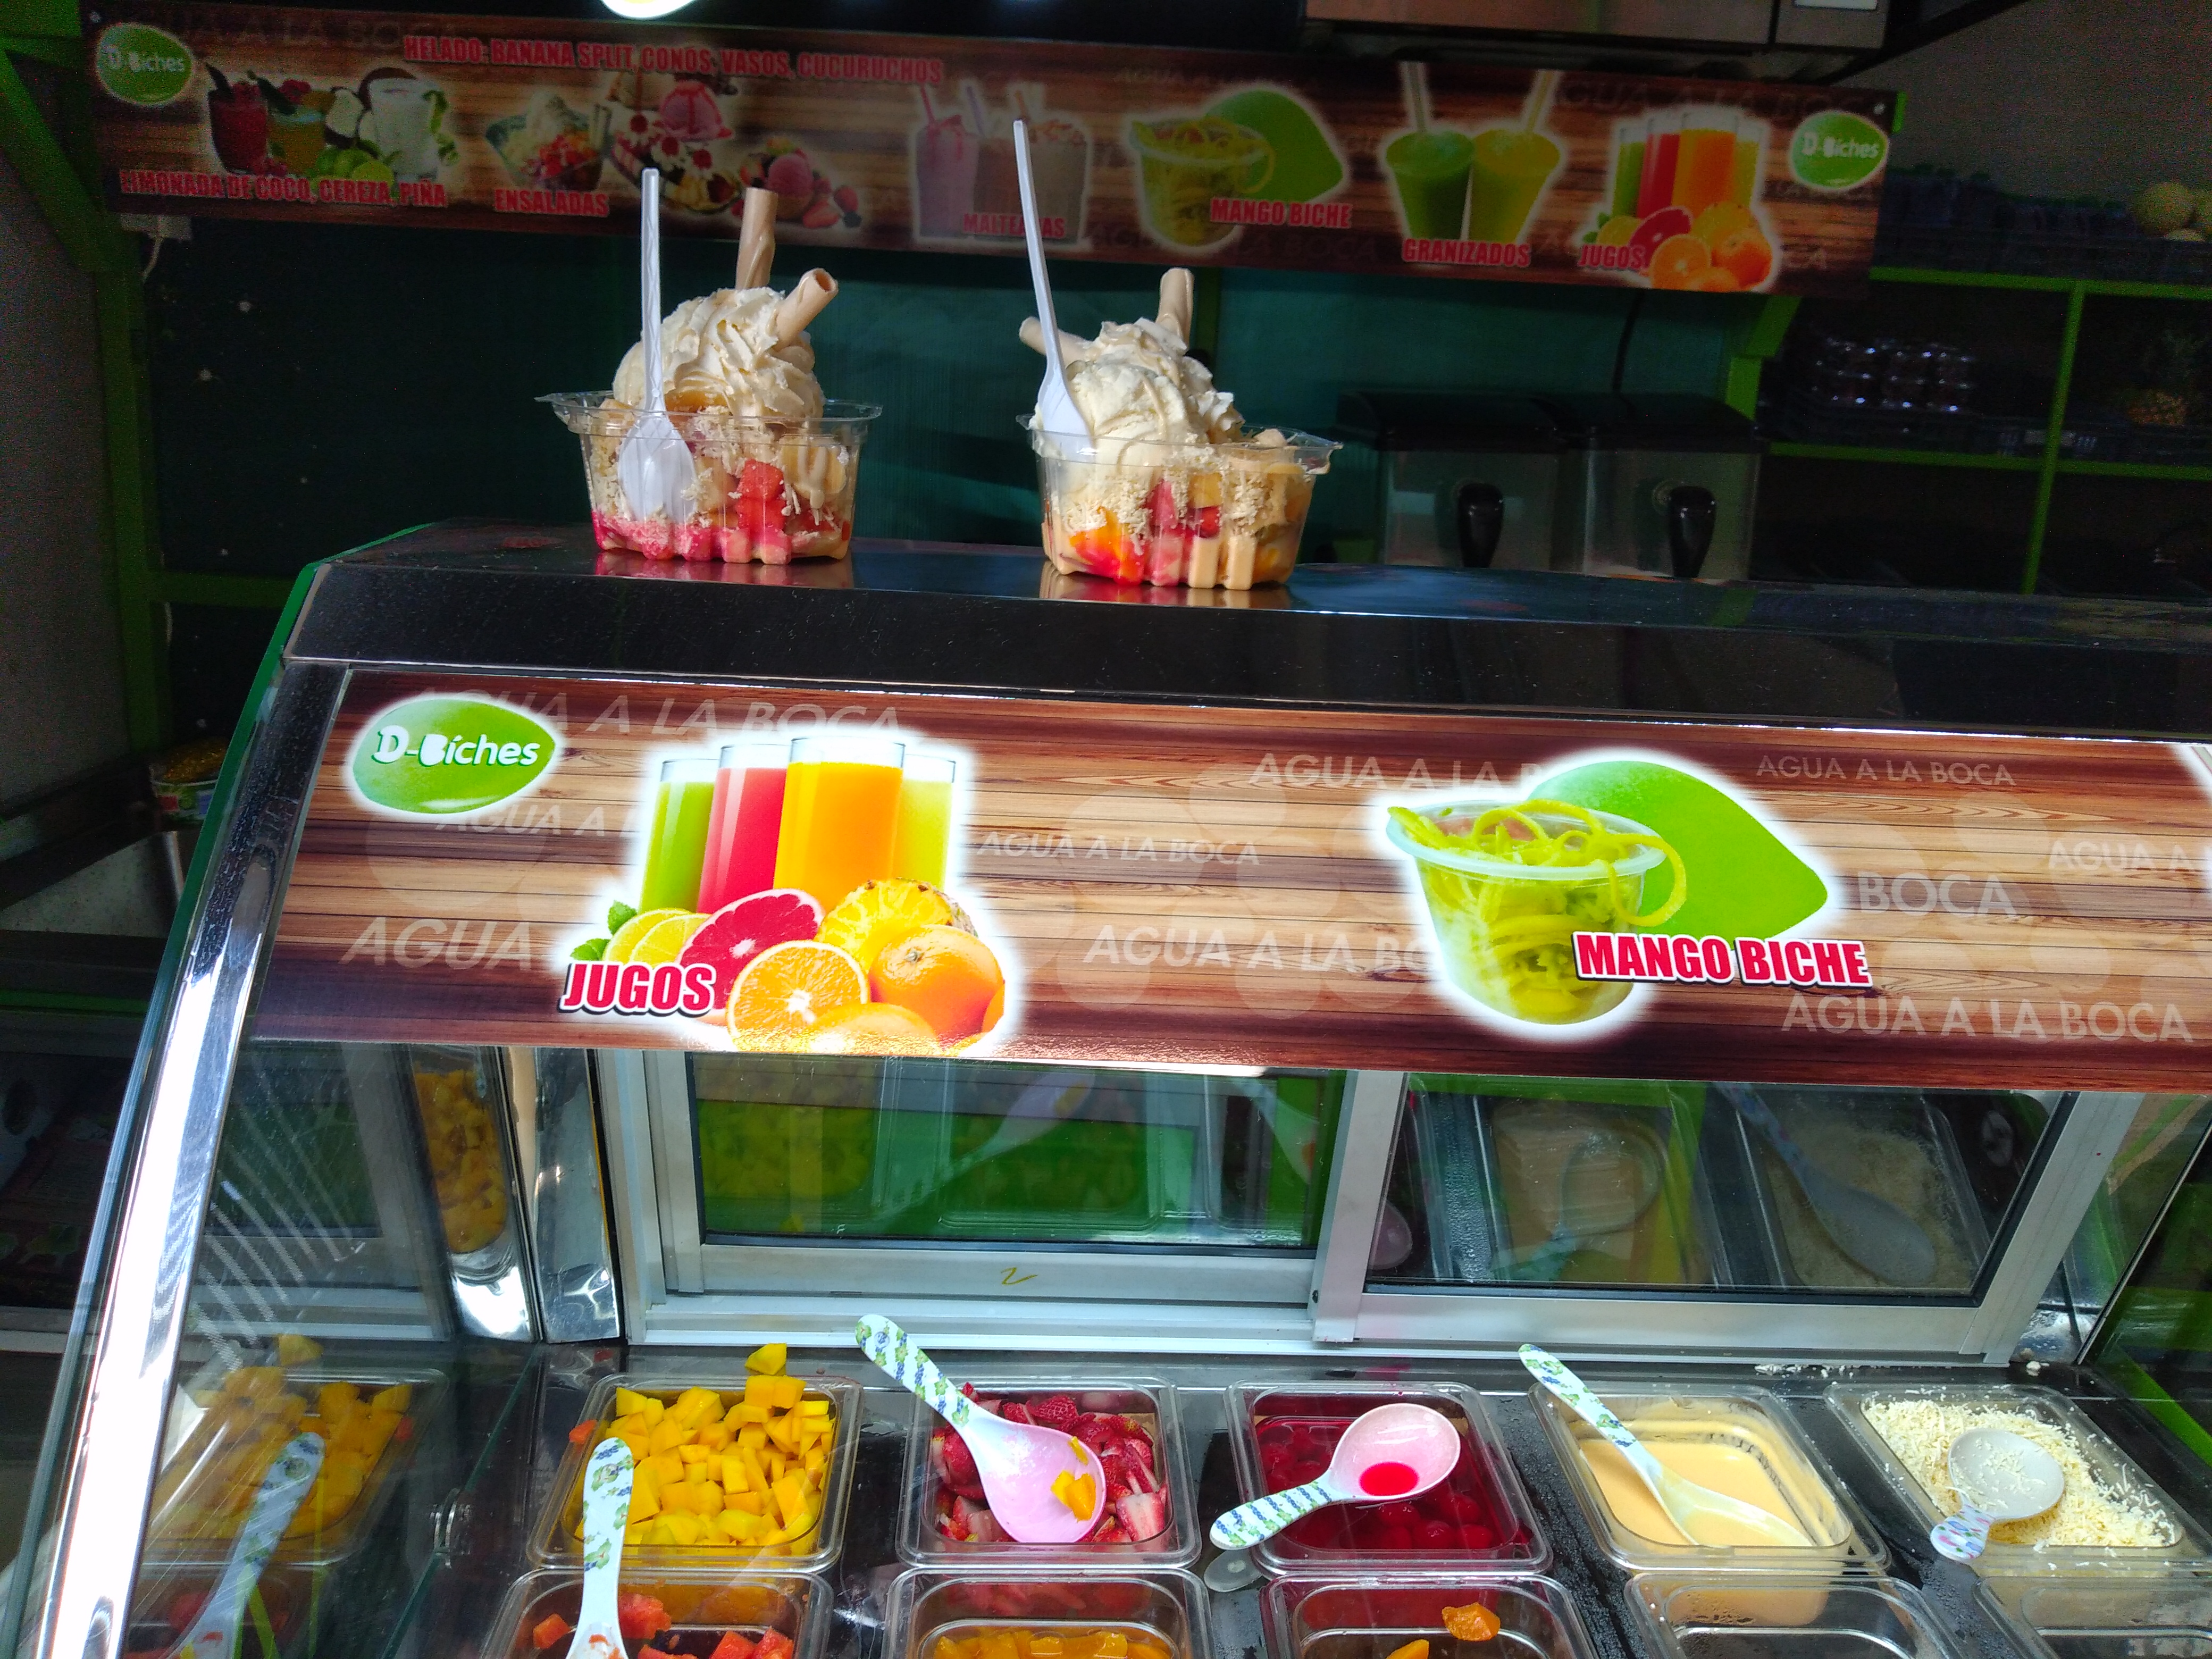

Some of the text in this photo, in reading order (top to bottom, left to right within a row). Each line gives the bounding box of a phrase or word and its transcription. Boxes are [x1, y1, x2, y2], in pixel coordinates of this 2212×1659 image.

[404, 35, 488, 63] HELADO:
[490, 38, 575, 67] BANANA
[719, 48, 794, 78] VASOS,
[798, 52, 944, 85] CUCURUCHOS
[120, 169, 225, 199] LIMONADA
[227, 174, 253, 199] DE
[399, 177, 448, 208] PIÑA
[494, 188, 610, 217] ENSALADAS
[962, 213, 1066, 239] MALTEAAS
[1209, 197, 1353, 229] MANGO BICHE
[1401, 237, 1531, 268] GRANIZADOS
[1577, 244, 1645, 271] JUGOS
[585, 695, 631, 734] A
[651, 698, 719, 735] LA
[1249, 752, 1388, 789] AGUA
[1401, 758, 1435, 790] A
[1756, 755, 2016, 786] AGUA A LA BOCA
[573, 806, 605, 837] A
[976, 831, 1260, 866] AGUA A LA BOCA
[2047, 840, 2156, 872] AGUA
[2169, 844, 2192, 872] A
[1857, 871, 2018, 918] BOCA
[338, 916, 532, 970] AGUA
[1083, 924, 1232, 969] AGUA
[1246, 929, 1284, 970] A
[1300, 933, 1361, 973] LA
[1573, 932, 1873, 987] MANGO BICHE
[560, 961, 716, 1014] JUGOS
[1781, 992, 2194, 1043] AGUA A LA BOCA
